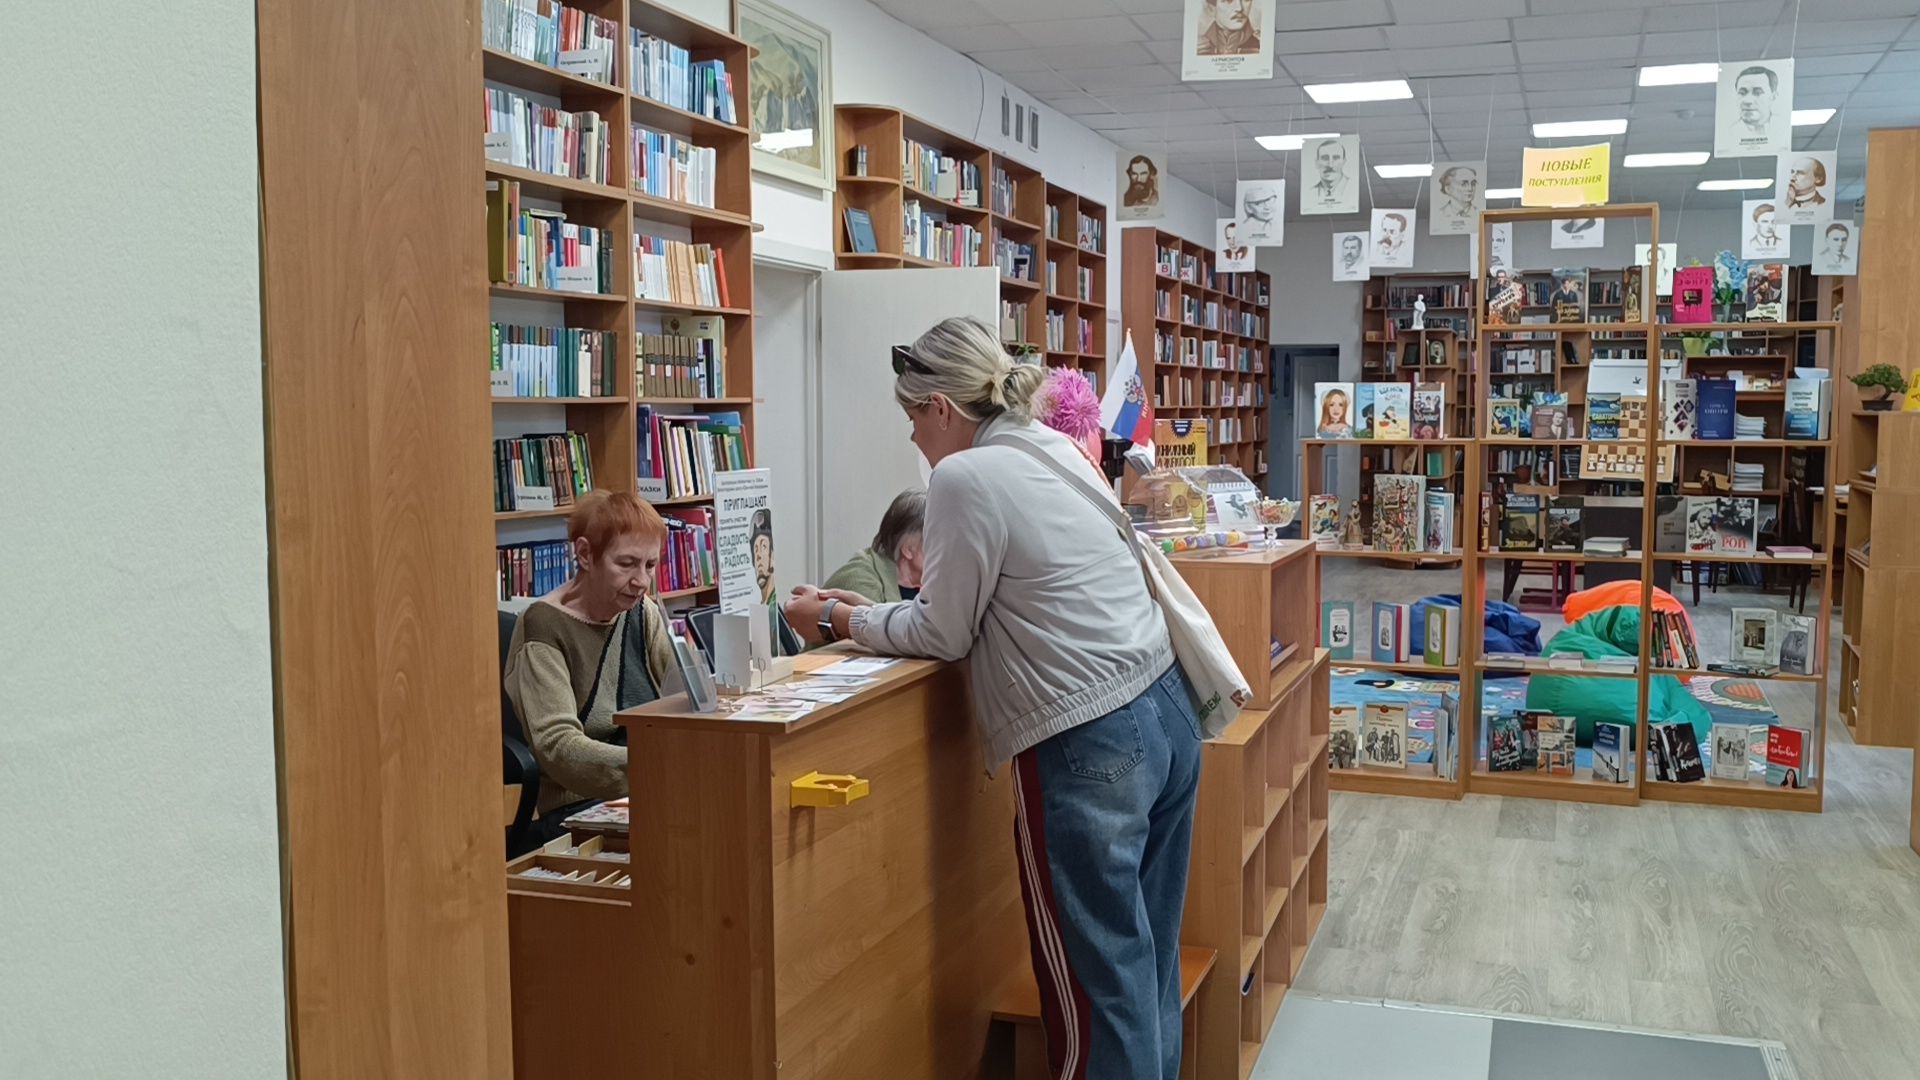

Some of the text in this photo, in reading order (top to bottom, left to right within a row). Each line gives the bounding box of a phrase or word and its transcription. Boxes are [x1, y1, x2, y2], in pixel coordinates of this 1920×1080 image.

[1541, 157, 1592, 172] НОВЫЕ
[1528, 174, 1602, 187] ПОСТУПЛЕНИЯ
[1161, 264, 1168, 273] В
[723, 495, 767, 511] ПРИГЛАШАЮТ
[718, 533, 749, 548] СЛАДОСТЬ
[724, 553, 750, 569] РАДОСТЬ
